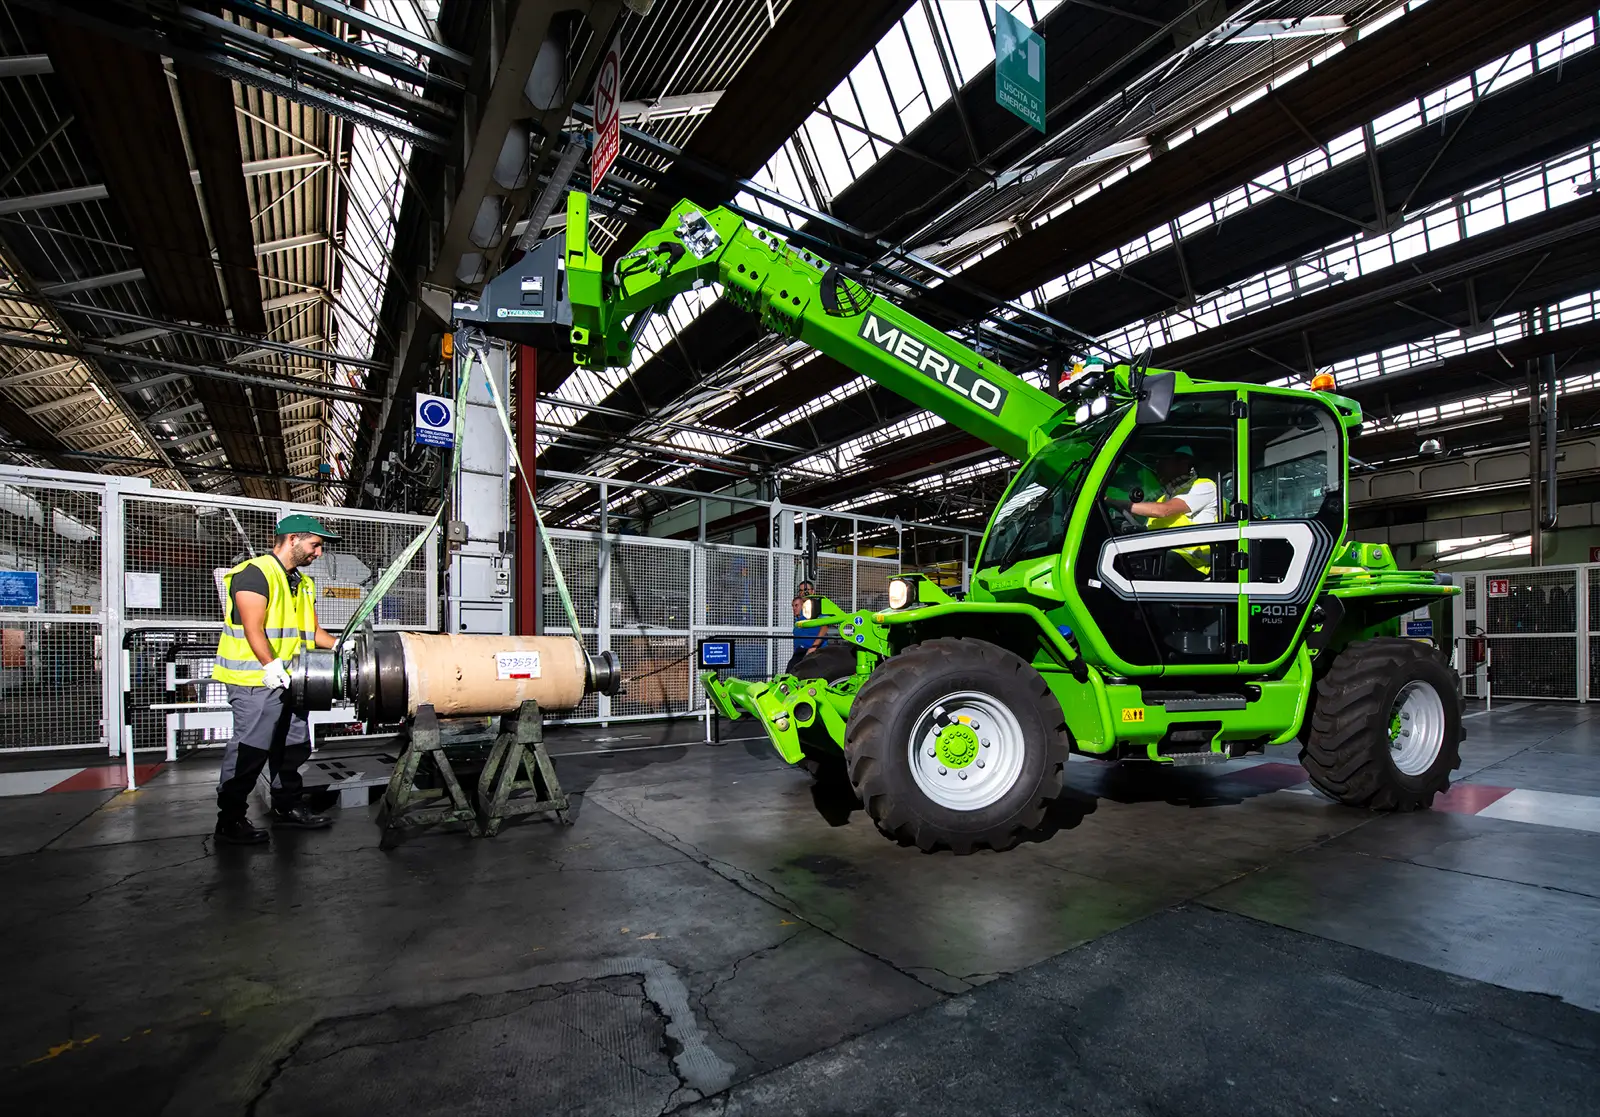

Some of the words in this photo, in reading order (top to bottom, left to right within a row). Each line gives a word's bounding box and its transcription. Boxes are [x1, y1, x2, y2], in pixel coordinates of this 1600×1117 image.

[1000, 90, 1041, 124] EMERGENZA
[1004, 80, 1028, 104] USCITA
[1031, 100, 1038, 111] DI
[593, 136, 617, 184] FUMARE
[594, 119, 617, 164] VIETATO
[862, 315, 1001, 410] MERLO
